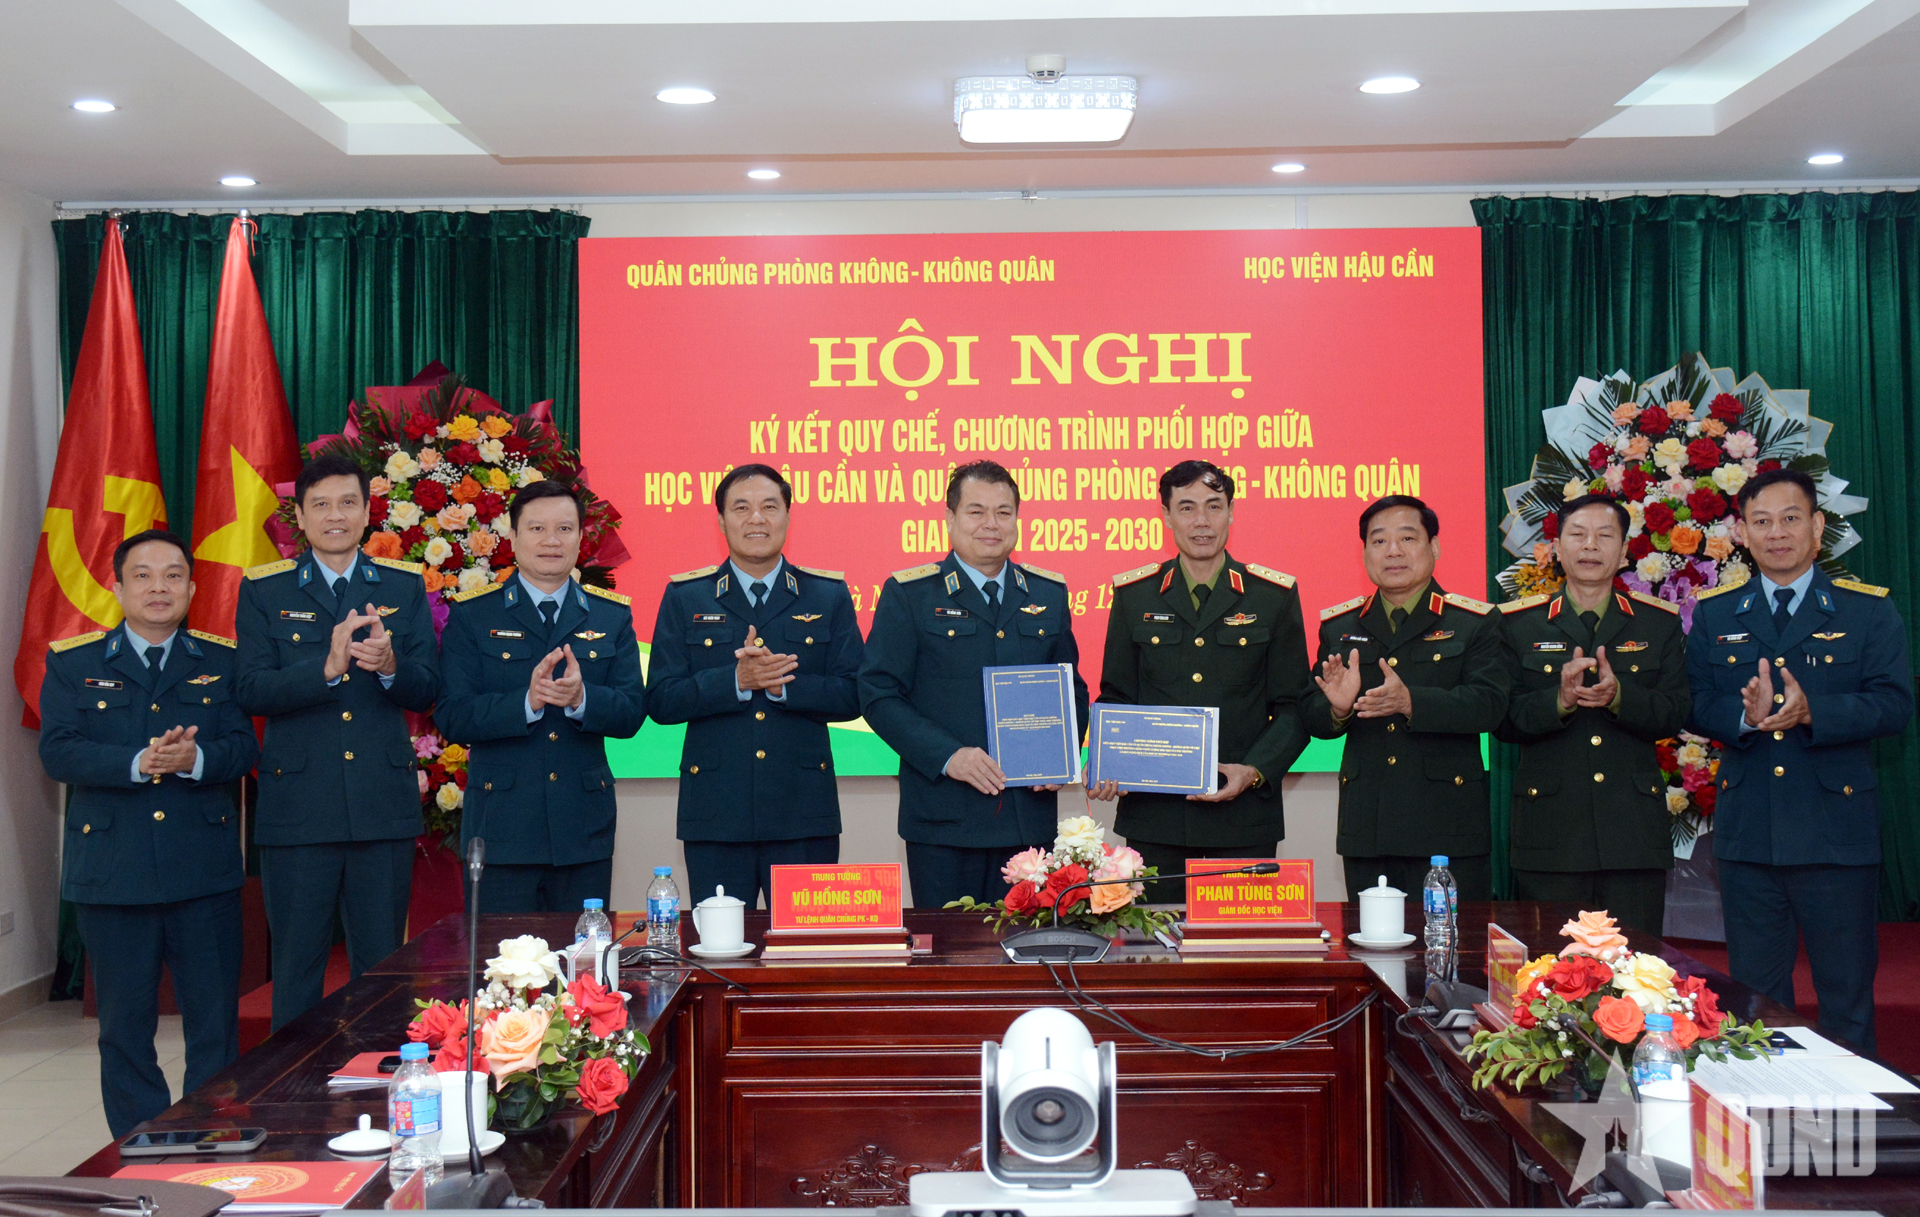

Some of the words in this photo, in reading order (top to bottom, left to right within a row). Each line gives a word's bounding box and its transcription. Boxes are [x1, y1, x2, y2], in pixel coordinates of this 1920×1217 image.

[627, 259, 683, 288] QUÂN
[688, 256, 758, 286] CHỦNG
[764, 257, 834, 285] PHÒNG
[998, 255, 1055, 285] QUÂN
[1244, 256, 1285, 284] HỌC
[1290, 251, 1338, 283] VIỆN
[1344, 251, 1385, 283] HẬU
[1391, 247, 1434, 278] CẦN
[809, 317, 980, 402] HỘI
[1010, 332, 1252, 399] NGHỊ
[750, 413, 781, 454] KÝ
[787, 409, 832, 454] KẾT
[838, 419, 885, 457] QUY
[892, 408, 946, 457] CHẾ,
[953, 414, 1052, 452] CHƯƠNG
[1058, 409, 1130, 451] TRÌNH
[1137, 404, 1194, 450] PHỐI
[1200, 412, 1249, 457] HỢP
[1256, 408, 1315, 449] GIỮA
[645, 471, 693, 512] HỌC
[817, 458, 867, 504] CẦN
[874, 462, 906, 503] VÀ
[1010, 456, 1068, 502] ỦNG
[1075, 459, 1157, 501] PHÒNG
[1354, 457, 1421, 502] QUÂN
[811, 873, 836, 882] TRUNG
[836, 870, 861, 881] TƯỚNG
[1196, 885, 1234, 901] PHAN
[1237, 882, 1273, 901] TÙNG
[1276, 883, 1305, 901] SƠN
[792, 888, 810, 906] VŨ
[813, 886, 851, 906] HỒNG
[853, 888, 882, 905] SƠN
[1218, 905, 1236, 915] GIÁM
[1237, 904, 1251, 915] ĐỐC
[1252, 906, 1266, 916] HỌC
[1267, 905, 1283, 916] VIỆN
